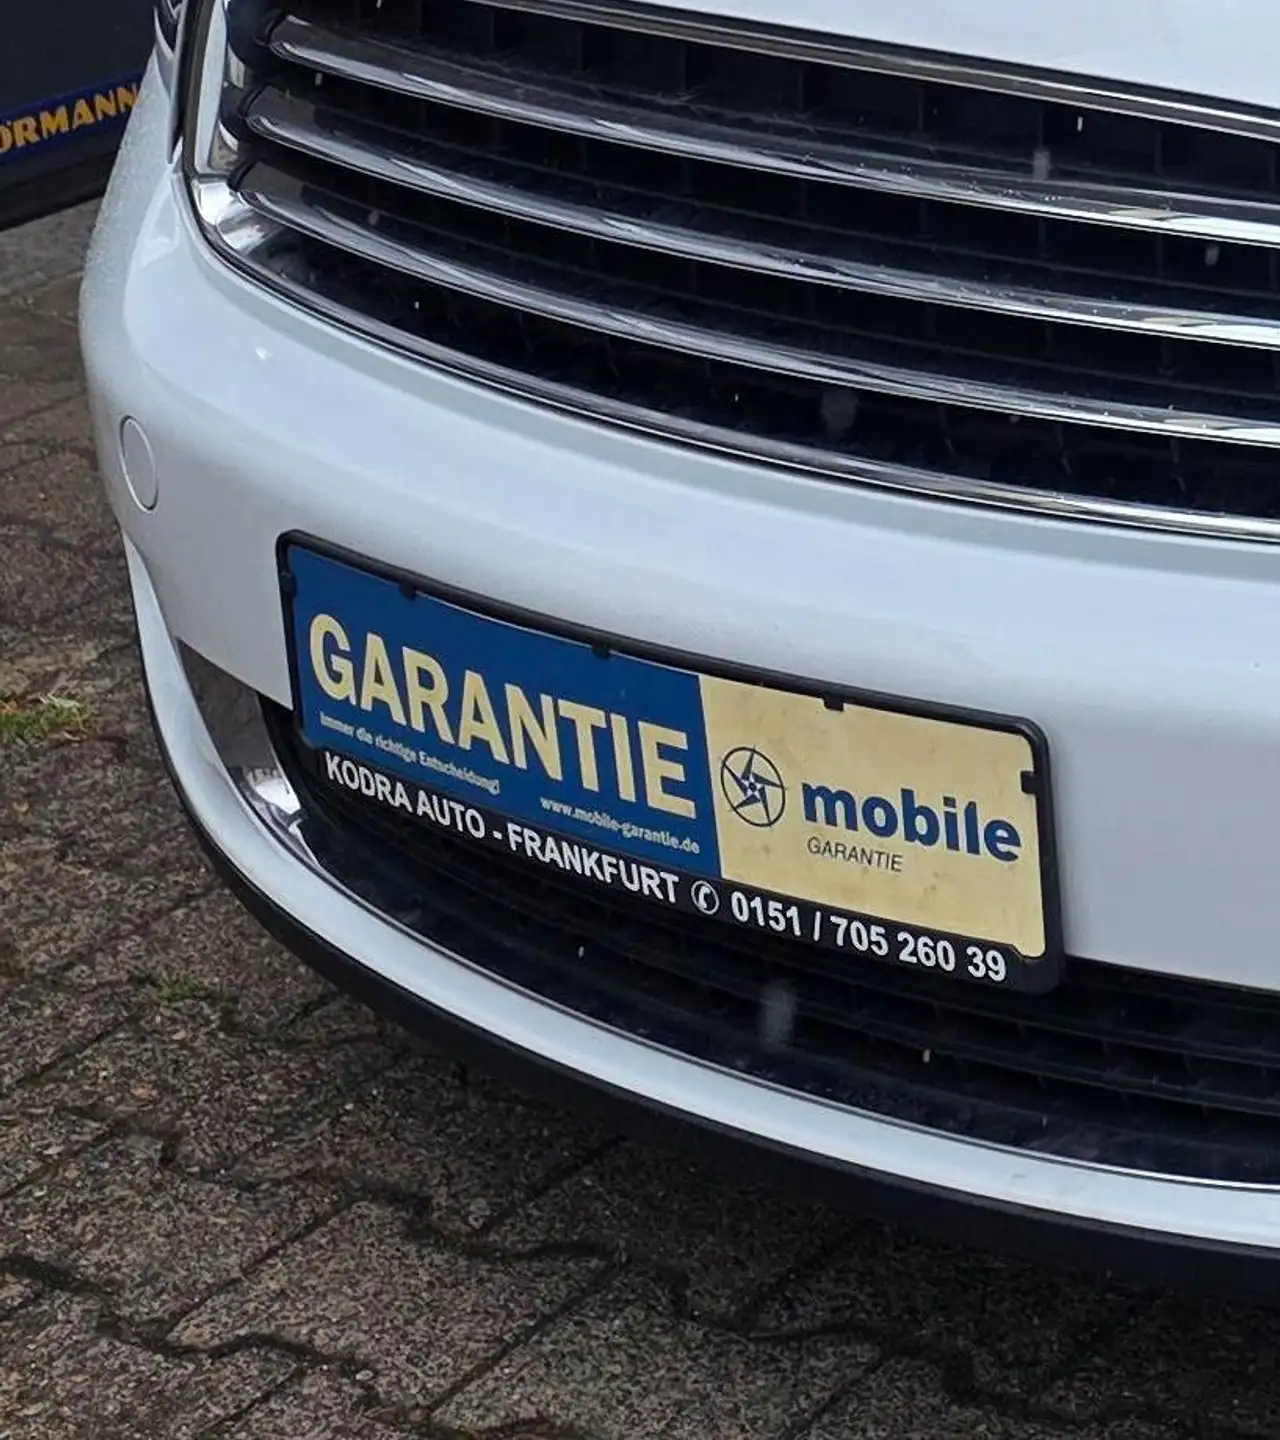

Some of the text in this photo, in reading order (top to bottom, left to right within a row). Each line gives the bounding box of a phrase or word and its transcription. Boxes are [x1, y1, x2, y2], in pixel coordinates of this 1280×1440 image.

[309, 613, 697, 820] GARANTIE
[539, 796, 701, 854] www.mobile-garantie.de
[801, 781, 1023, 863] mobile
[806, 836, 904, 874] GARANTIE
[324, 750, 414, 814] KODRA
[417, 789, 486, 840] AUTO
[506, 821, 680, 904] FRANKFURT
[731, 890, 802, 938] 0151
[829, 913, 890, 957] 705
[896, 930, 957, 973] 260
[965, 945, 1008, 983] 39
